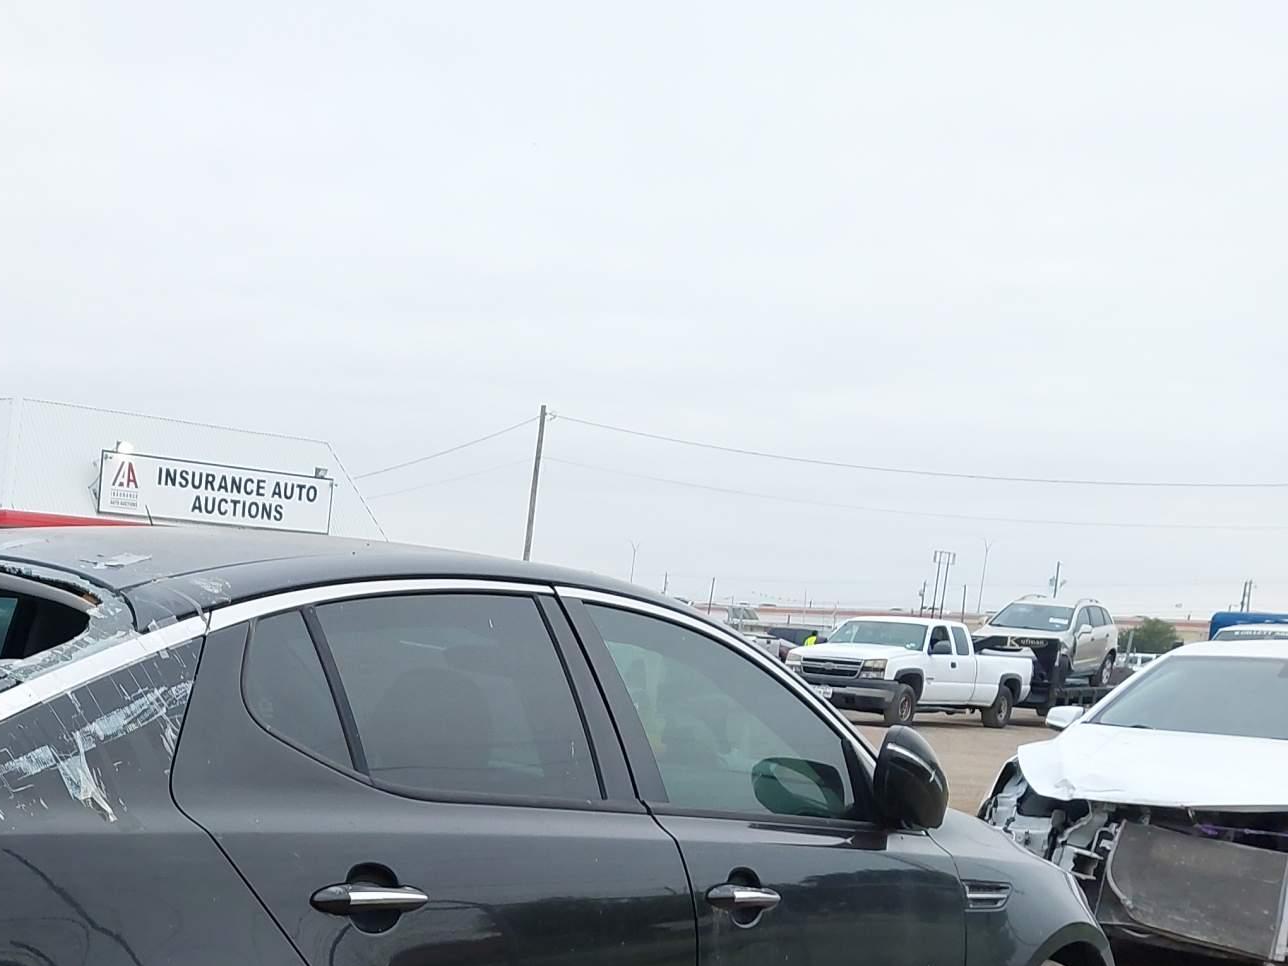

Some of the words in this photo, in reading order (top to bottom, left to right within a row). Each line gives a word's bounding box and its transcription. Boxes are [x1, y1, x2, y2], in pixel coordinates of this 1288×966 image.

[157, 466, 266, 497] INSURANCE
[271, 481, 318, 503] AUTO
[191, 495, 284, 521] AUCTIONS
